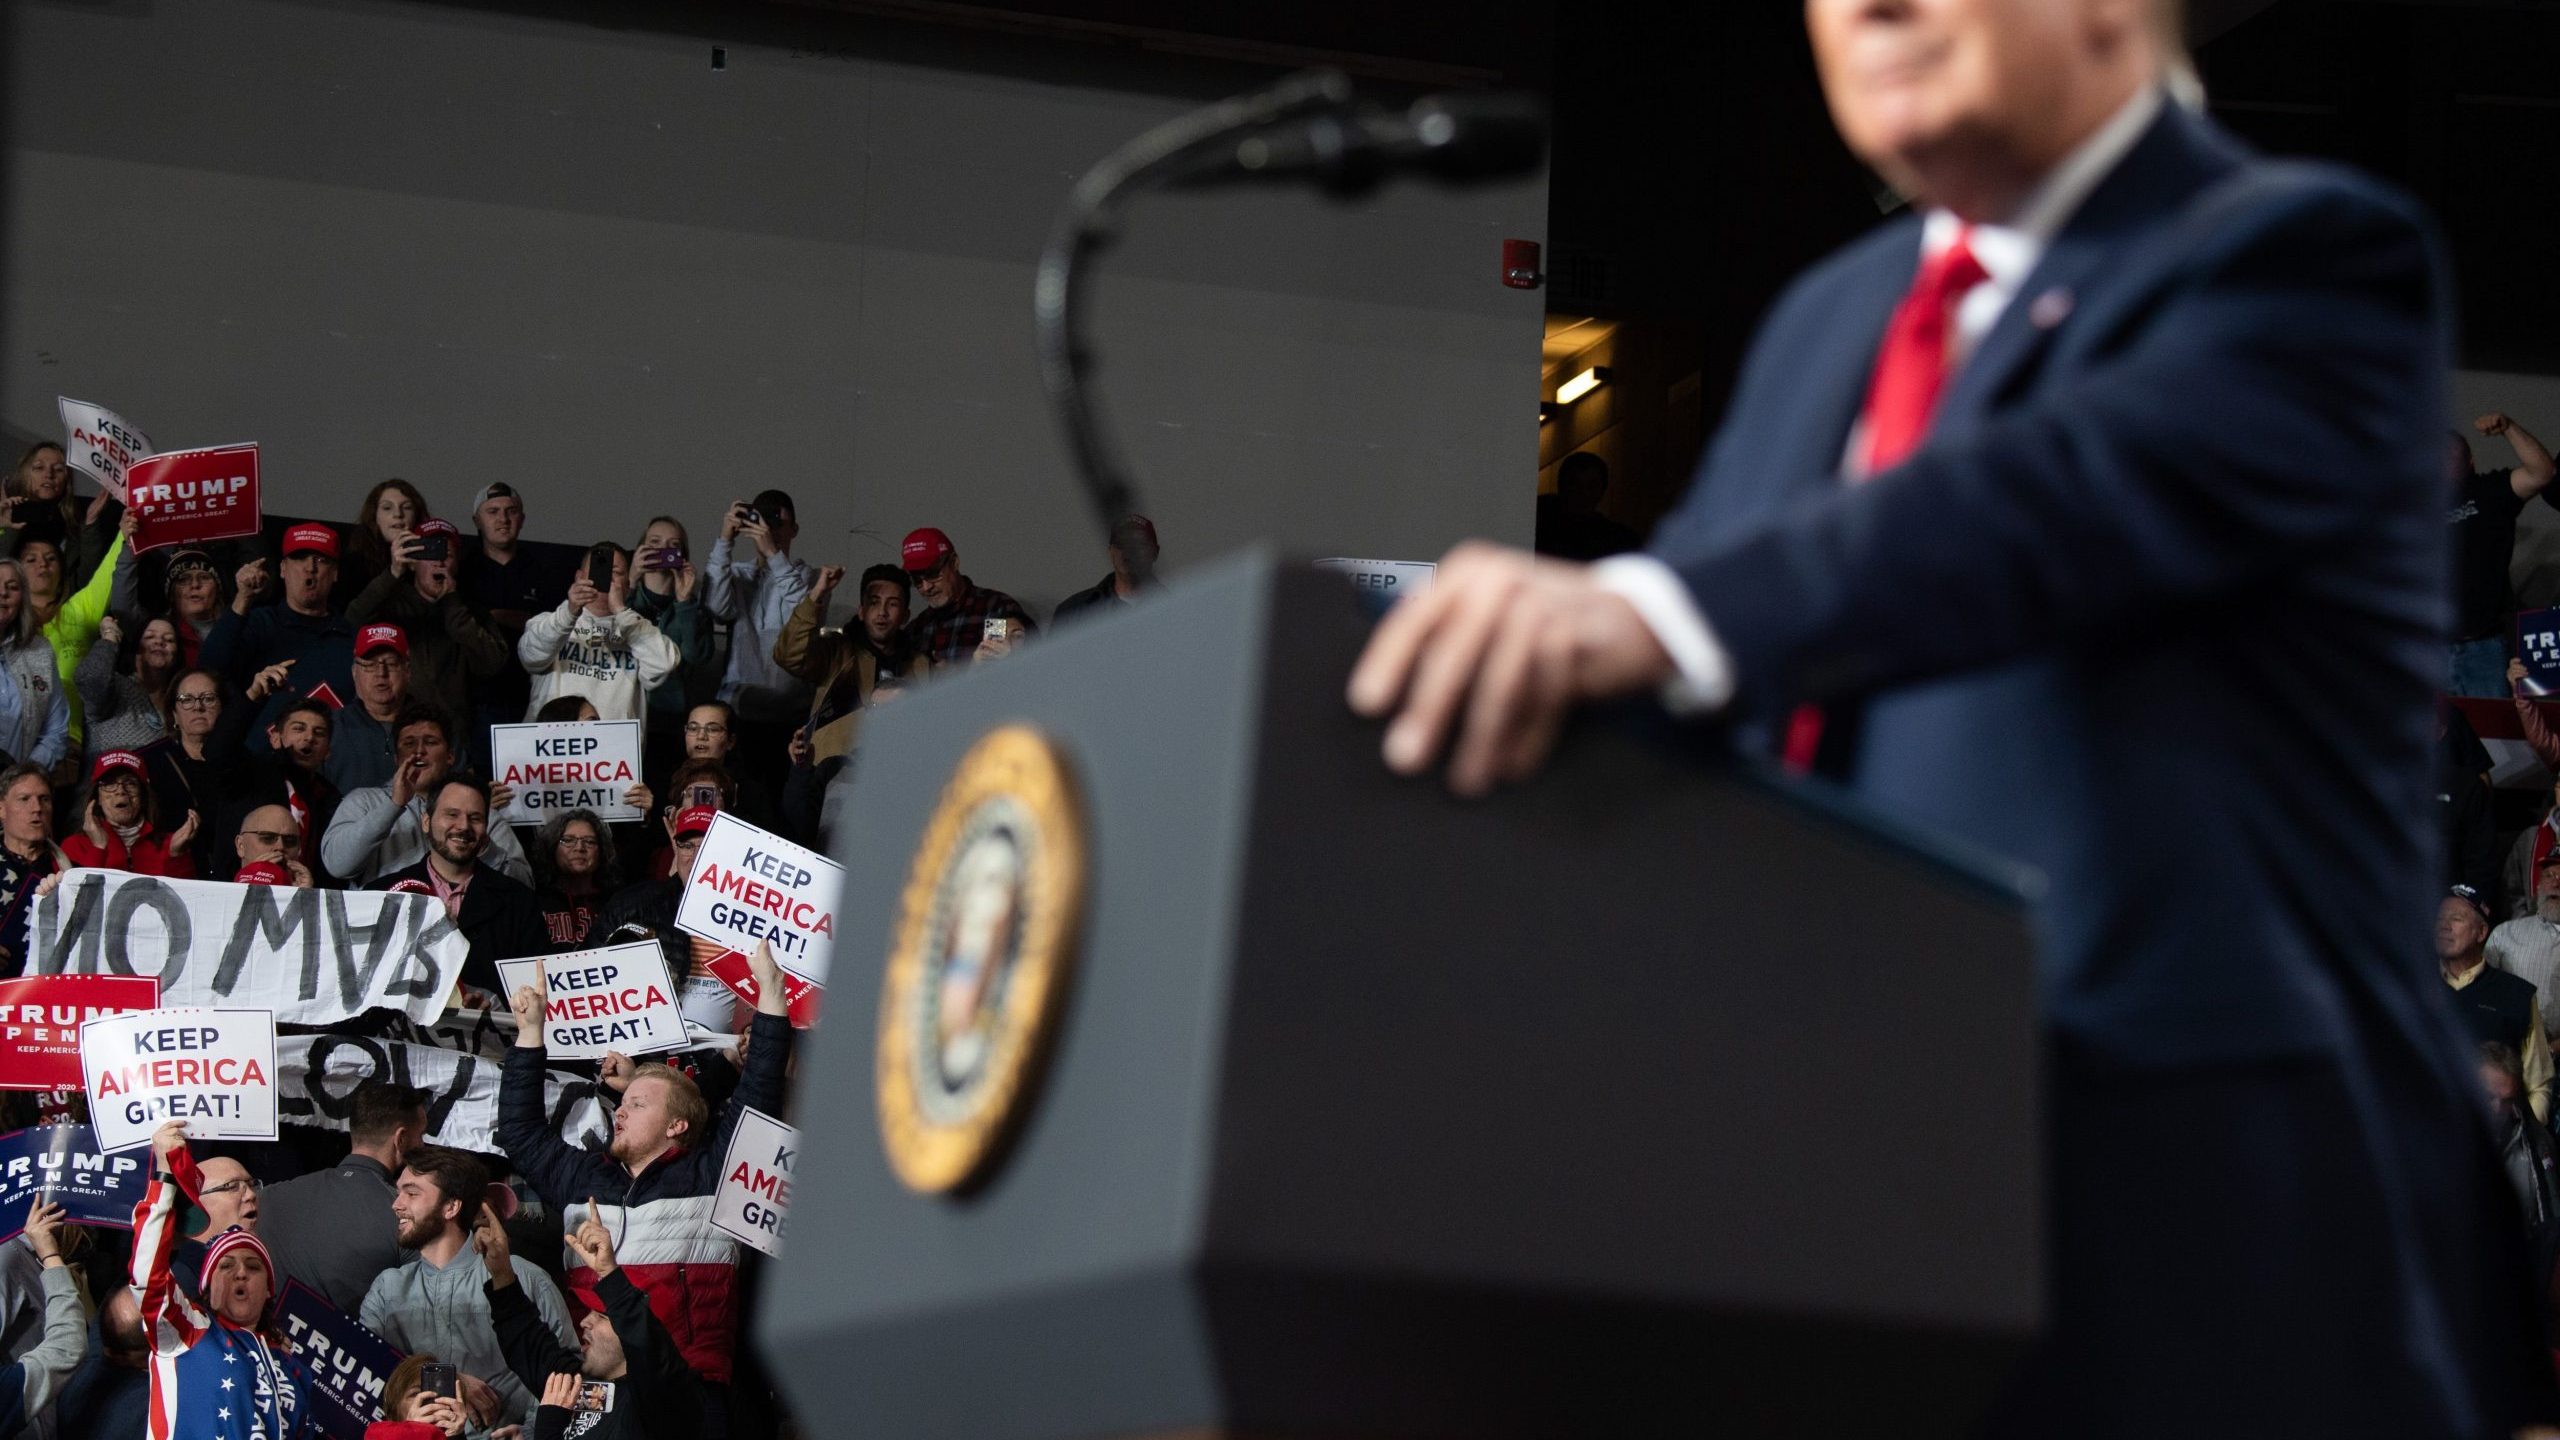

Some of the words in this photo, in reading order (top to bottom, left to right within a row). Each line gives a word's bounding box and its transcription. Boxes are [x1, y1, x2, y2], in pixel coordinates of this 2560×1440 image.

[97, 417, 142, 452] KEEP
[132, 476, 248, 504] TRUMP
[143, 495, 238, 517] PENCE
[171, 512, 203, 521] AMERICA
[2523, 631, 2560, 649] TR
[559, 641, 635, 670] WALLEYE
[569, 663, 617, 681] HOCKEY
[535, 738, 598, 757] KEEP
[504, 760, 634, 785] AMERICA
[524, 787, 615, 809] GREAT!
[742, 847, 812, 889] KEEP
[697, 863, 833, 940] AMERICA
[543, 911, 575, 944] HIO
[576, 907, 592, 942] S
[710, 902, 807, 959] GREAT!
[547, 965, 618, 992] KEEP
[702, 979, 720, 988] BETSY
[794, 984, 815, 1000] AMER
[545, 985, 668, 1022] MERICA
[7, 1026, 76, 1042] PEN
[134, 1027, 219, 1055] KEEP
[553, 1017, 653, 1046] GREAT!
[17, 1045, 41, 1053] KEEP
[56, 1083, 76, 1091] 2020
[98, 1058, 267, 1100] AMERICA
[125, 1094, 240, 1125] GREAT!
[0, 1152, 138, 1178] RUMP
[4, 1191, 24, 1205] KEEP
[26, 1185, 68, 1195] AMERICA
[71, 1187, 106, 1197] GREAT!
[729, 1161, 793, 1209] AME
[742, 1202, 789, 1238] GRE
[287, 1313, 386, 1399] TRUM
[311, 1378, 345, 1406] AMERICA
